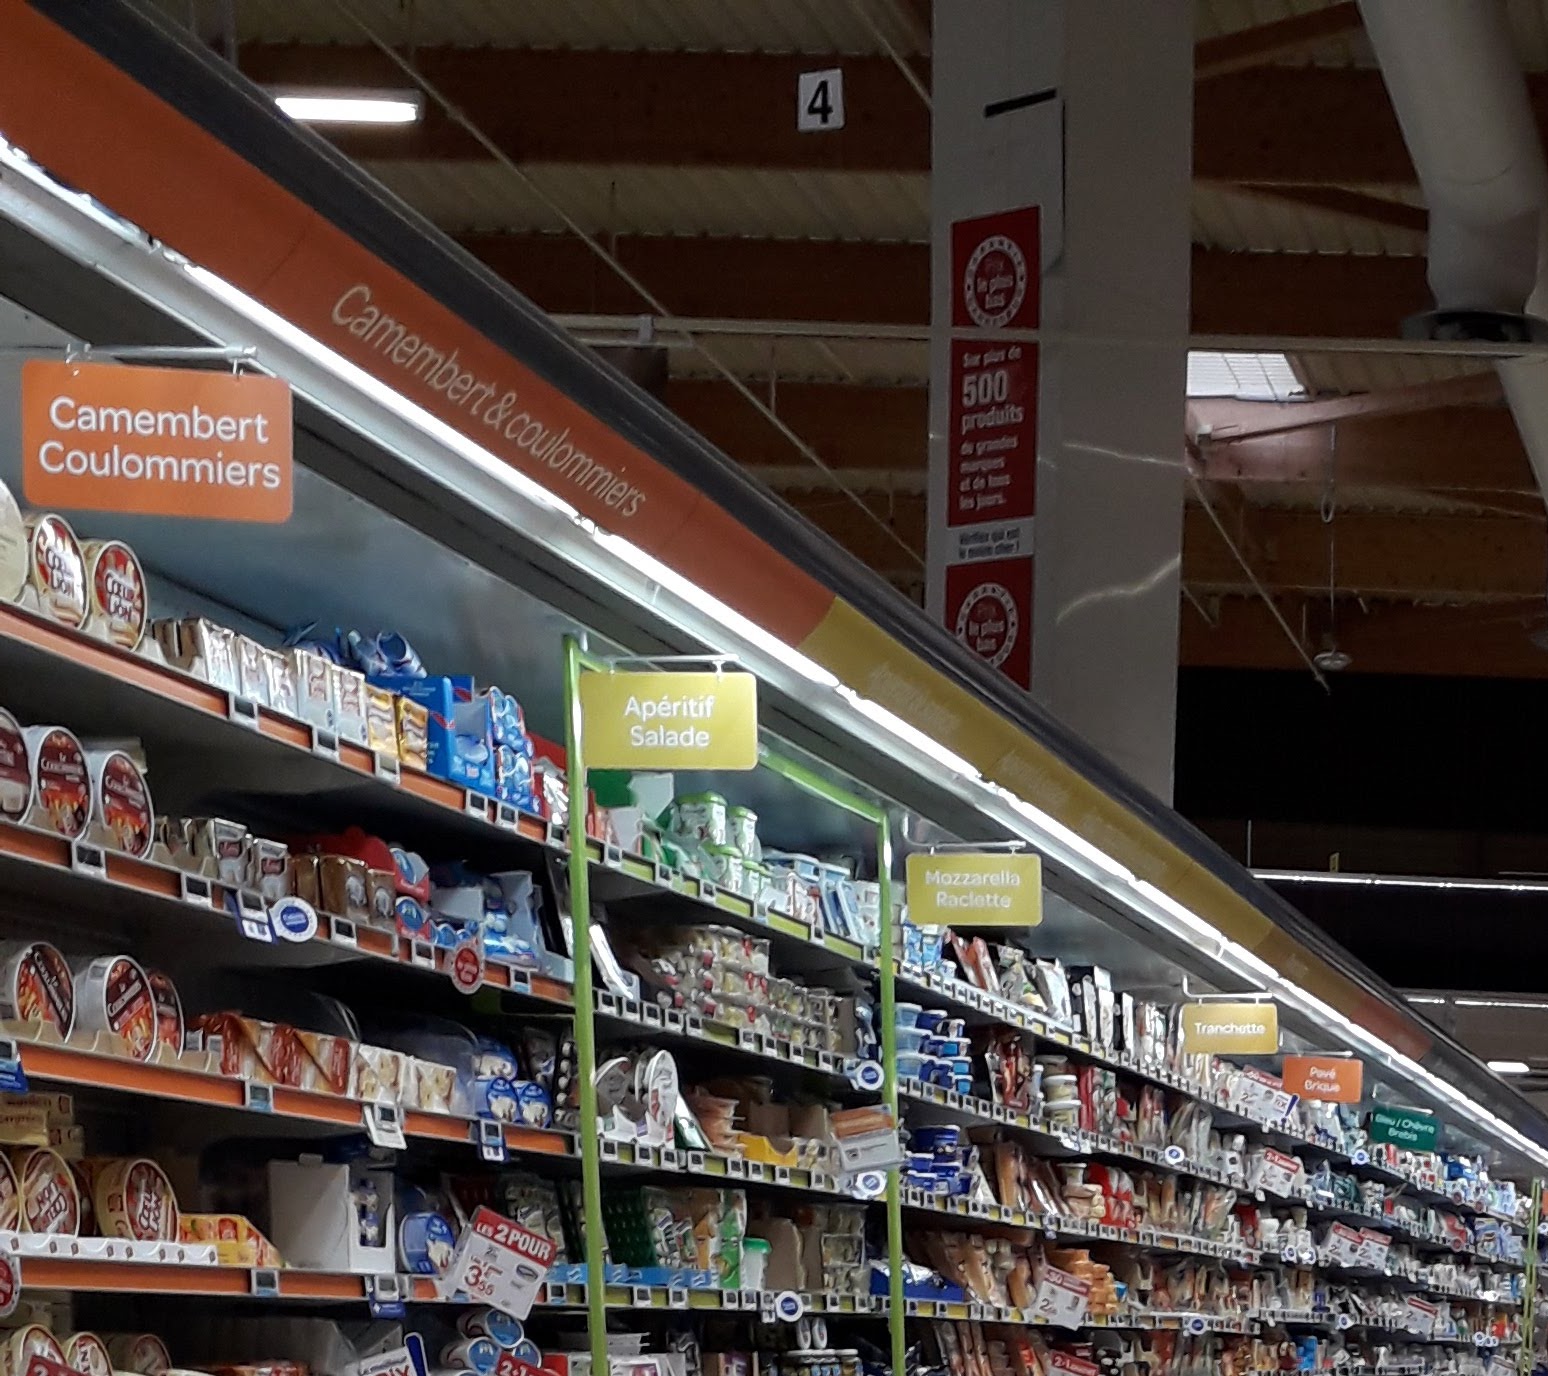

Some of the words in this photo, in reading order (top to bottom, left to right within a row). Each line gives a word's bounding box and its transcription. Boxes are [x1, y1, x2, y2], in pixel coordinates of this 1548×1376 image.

[807, 79, 834, 125] 4
[331, 285, 496, 417] Camembert
[483, 392, 517, 430] &
[503, 411, 647, 518] coulommiers
[961, 370, 1008, 408] 500
[49, 395, 270, 445] Camembert
[961, 404, 1026, 435] produits
[38, 439, 281, 490] Coulommiers
[624, 694, 716, 723] Apéritif
[630, 724, 711, 748] Salade
[925, 869, 1021, 886] Mozzarella
[936, 890, 1012, 909] Raclette
[1194, 1021, 1267, 1035] Tranchette
[494, 1223, 510, 1243] 2
[506, 1227, 552, 1261] POUR
